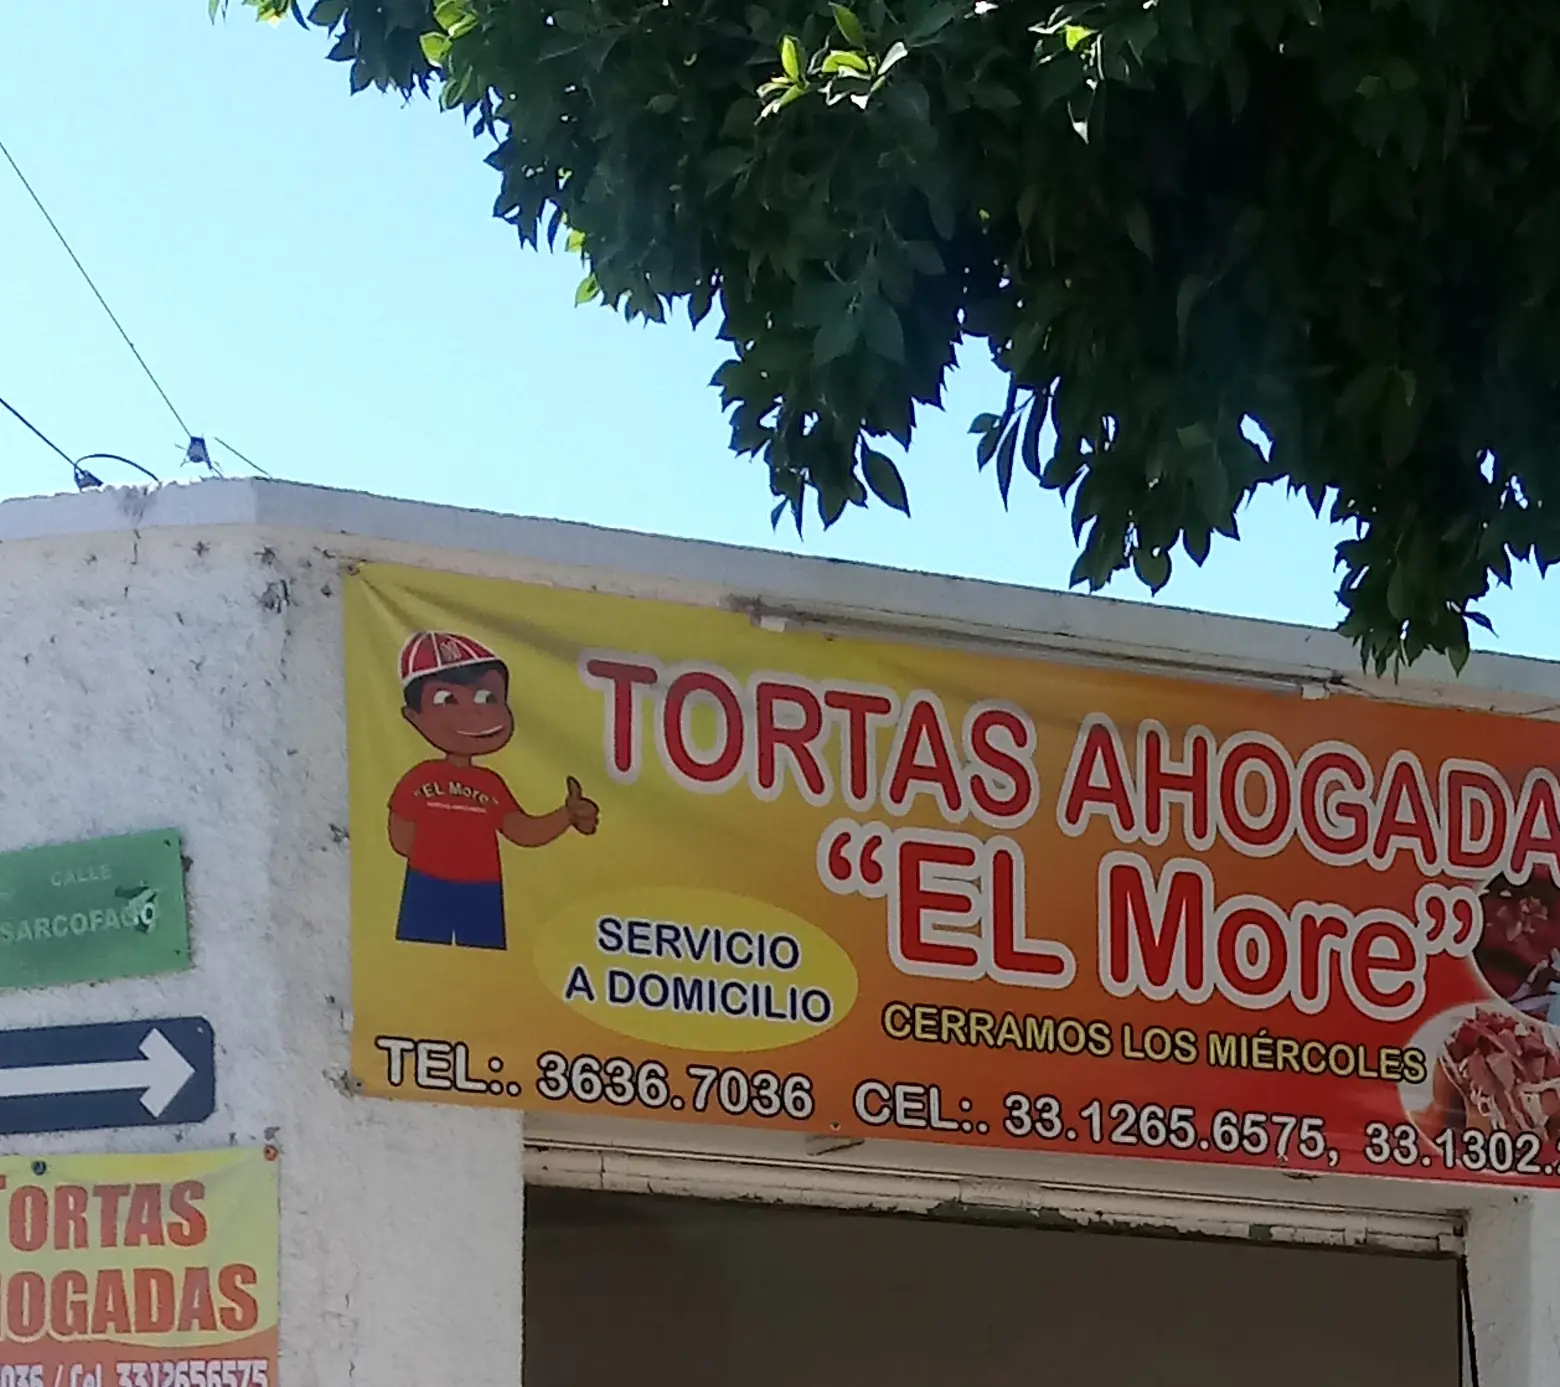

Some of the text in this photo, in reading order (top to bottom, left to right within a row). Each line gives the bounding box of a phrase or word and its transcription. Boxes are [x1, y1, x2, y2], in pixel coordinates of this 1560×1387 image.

[584, 654, 1036, 822] TORTAS
[51, 863, 112, 887] CALLE
[597, 916, 801, 970] SERVICIO
[564, 966, 832, 1025] A DOMICILIO
[882, 1001, 1427, 1084] CERRAMOS LOS MIÉRCOLES
[538, 1052, 814, 1120] 3636.7036
[1003, 1092, 1341, 1168] 33.1265.6575,
[0, 1174, 208, 1251] ORTAS
